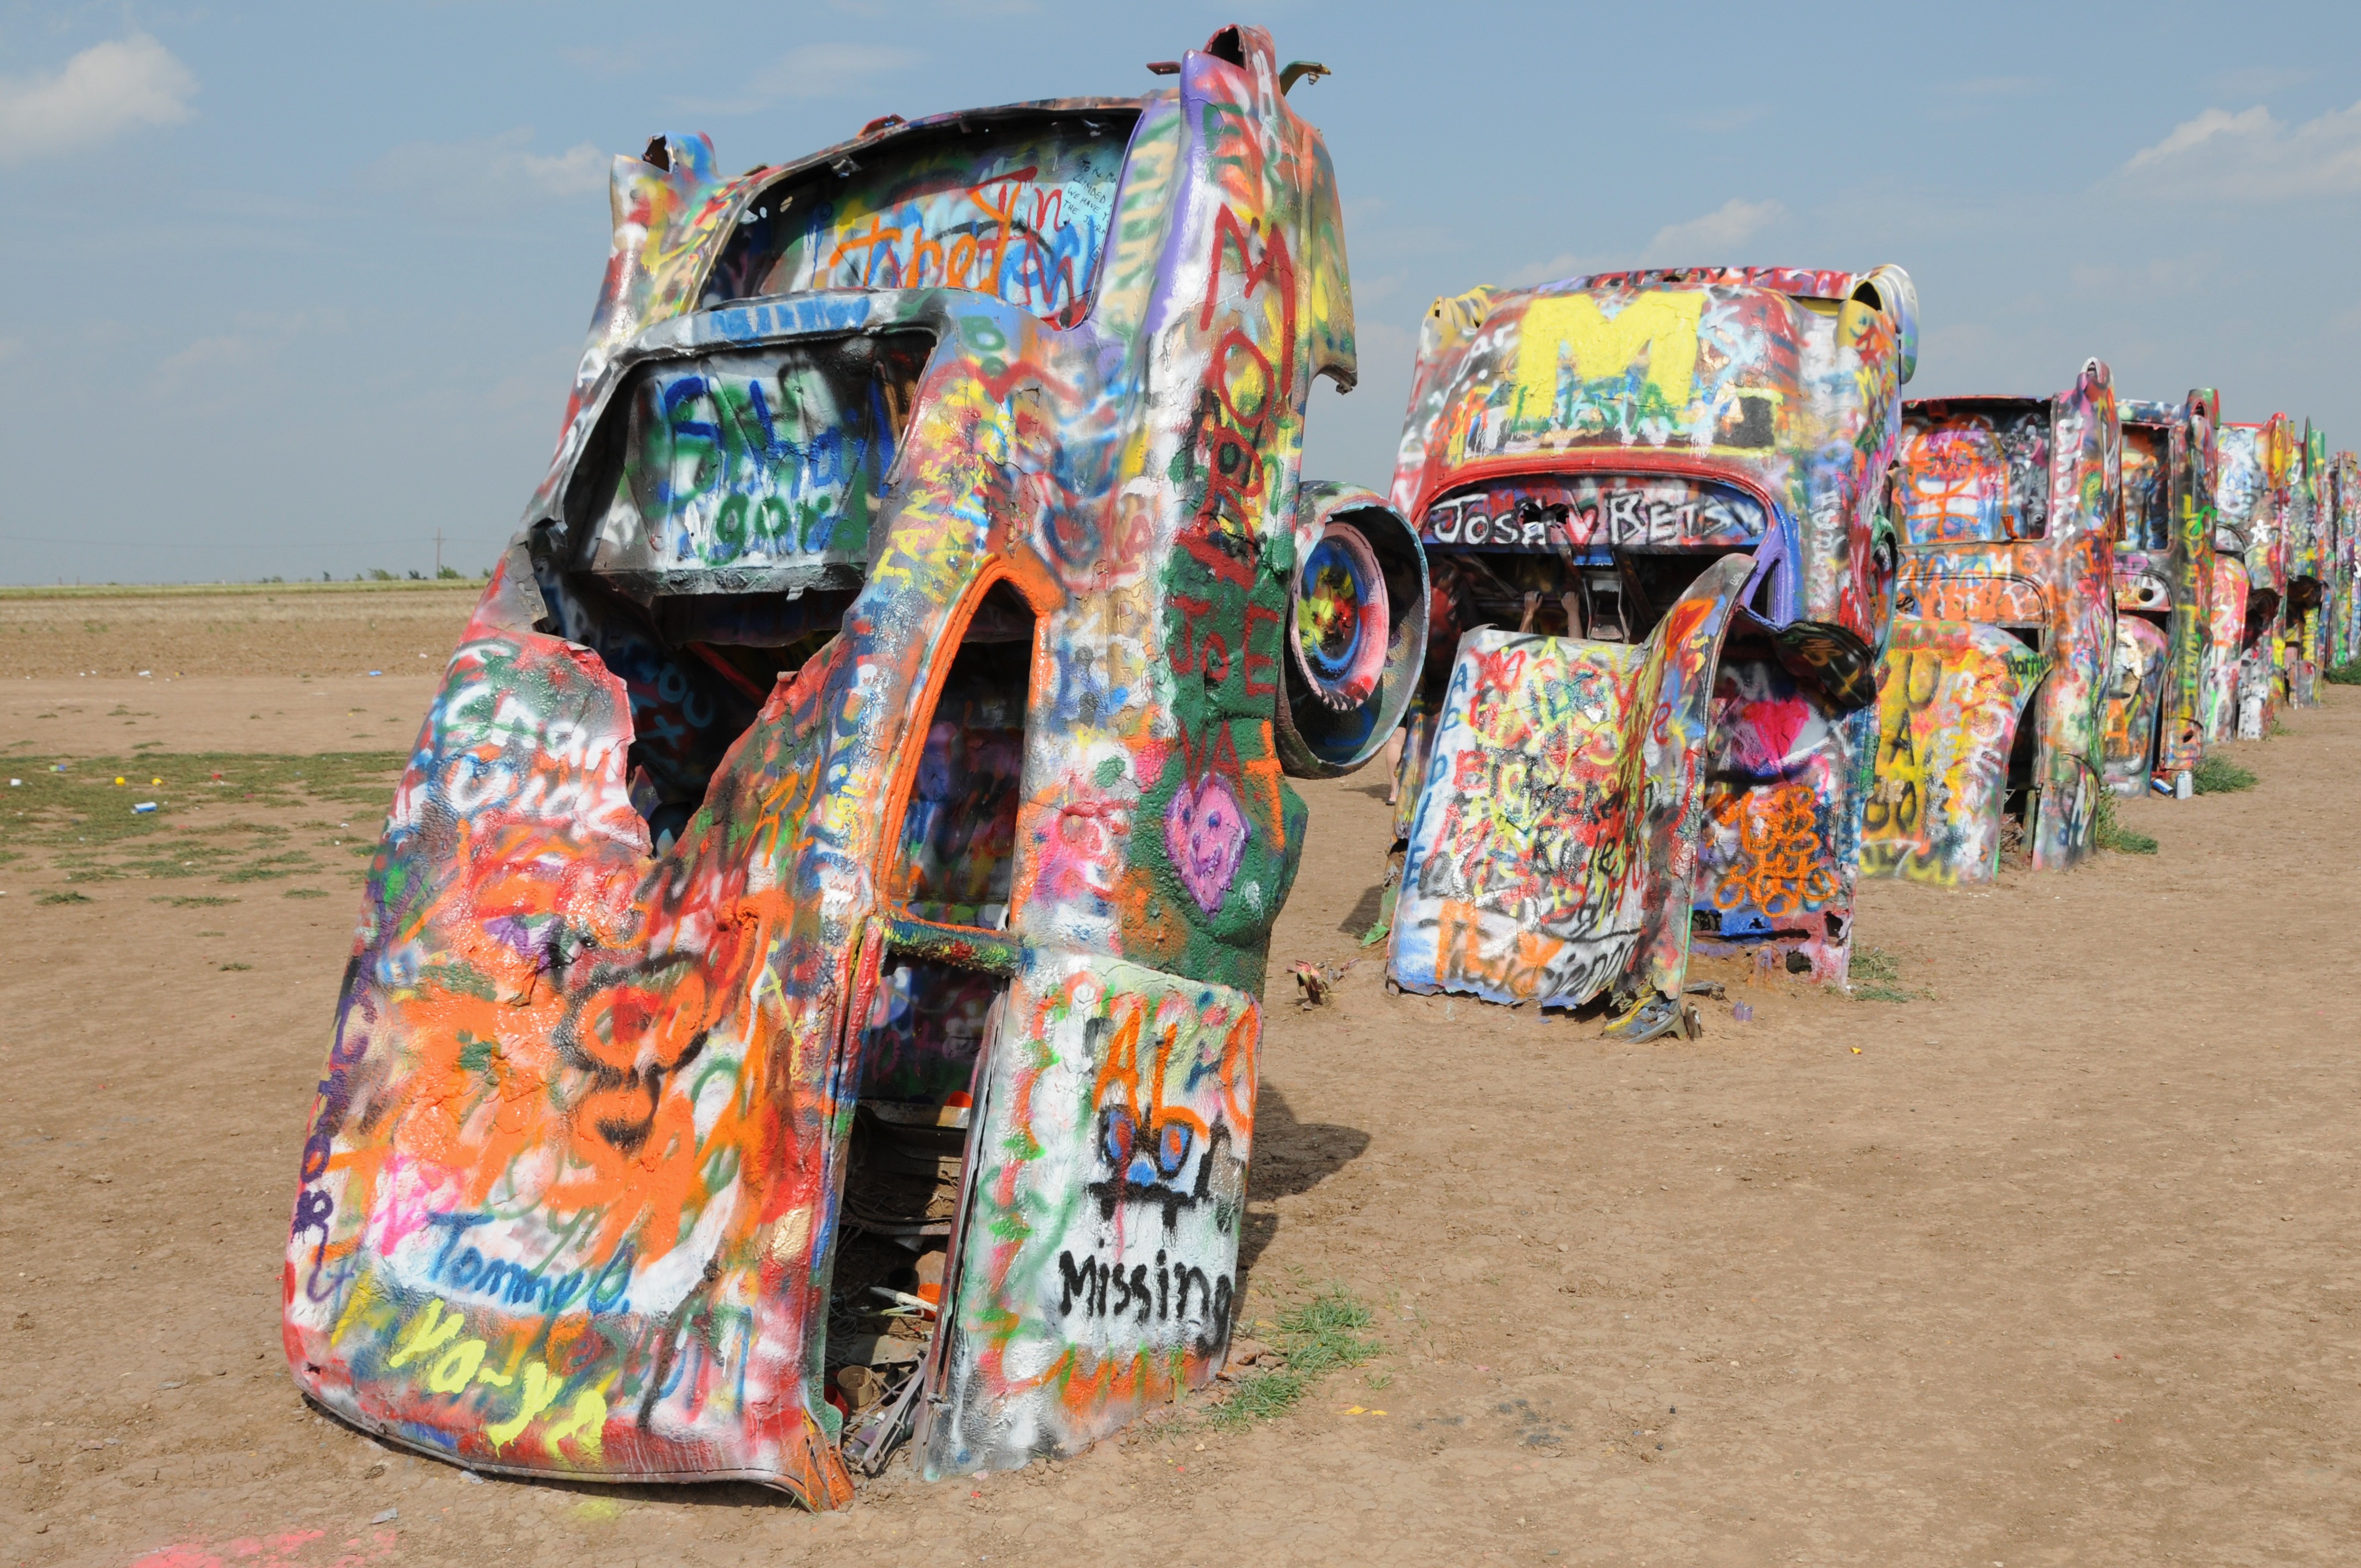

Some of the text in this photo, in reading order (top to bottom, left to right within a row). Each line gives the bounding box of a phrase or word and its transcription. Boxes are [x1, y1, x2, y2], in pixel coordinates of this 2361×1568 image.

[1068, 187, 1080, 199] WE
[1080, 197, 1101, 213] HAVE
[1073, 174, 1106, 204] CLIMBED
[1063, 199, 1079, 215] THE
[1058, 1249, 1233, 1358] Missing
